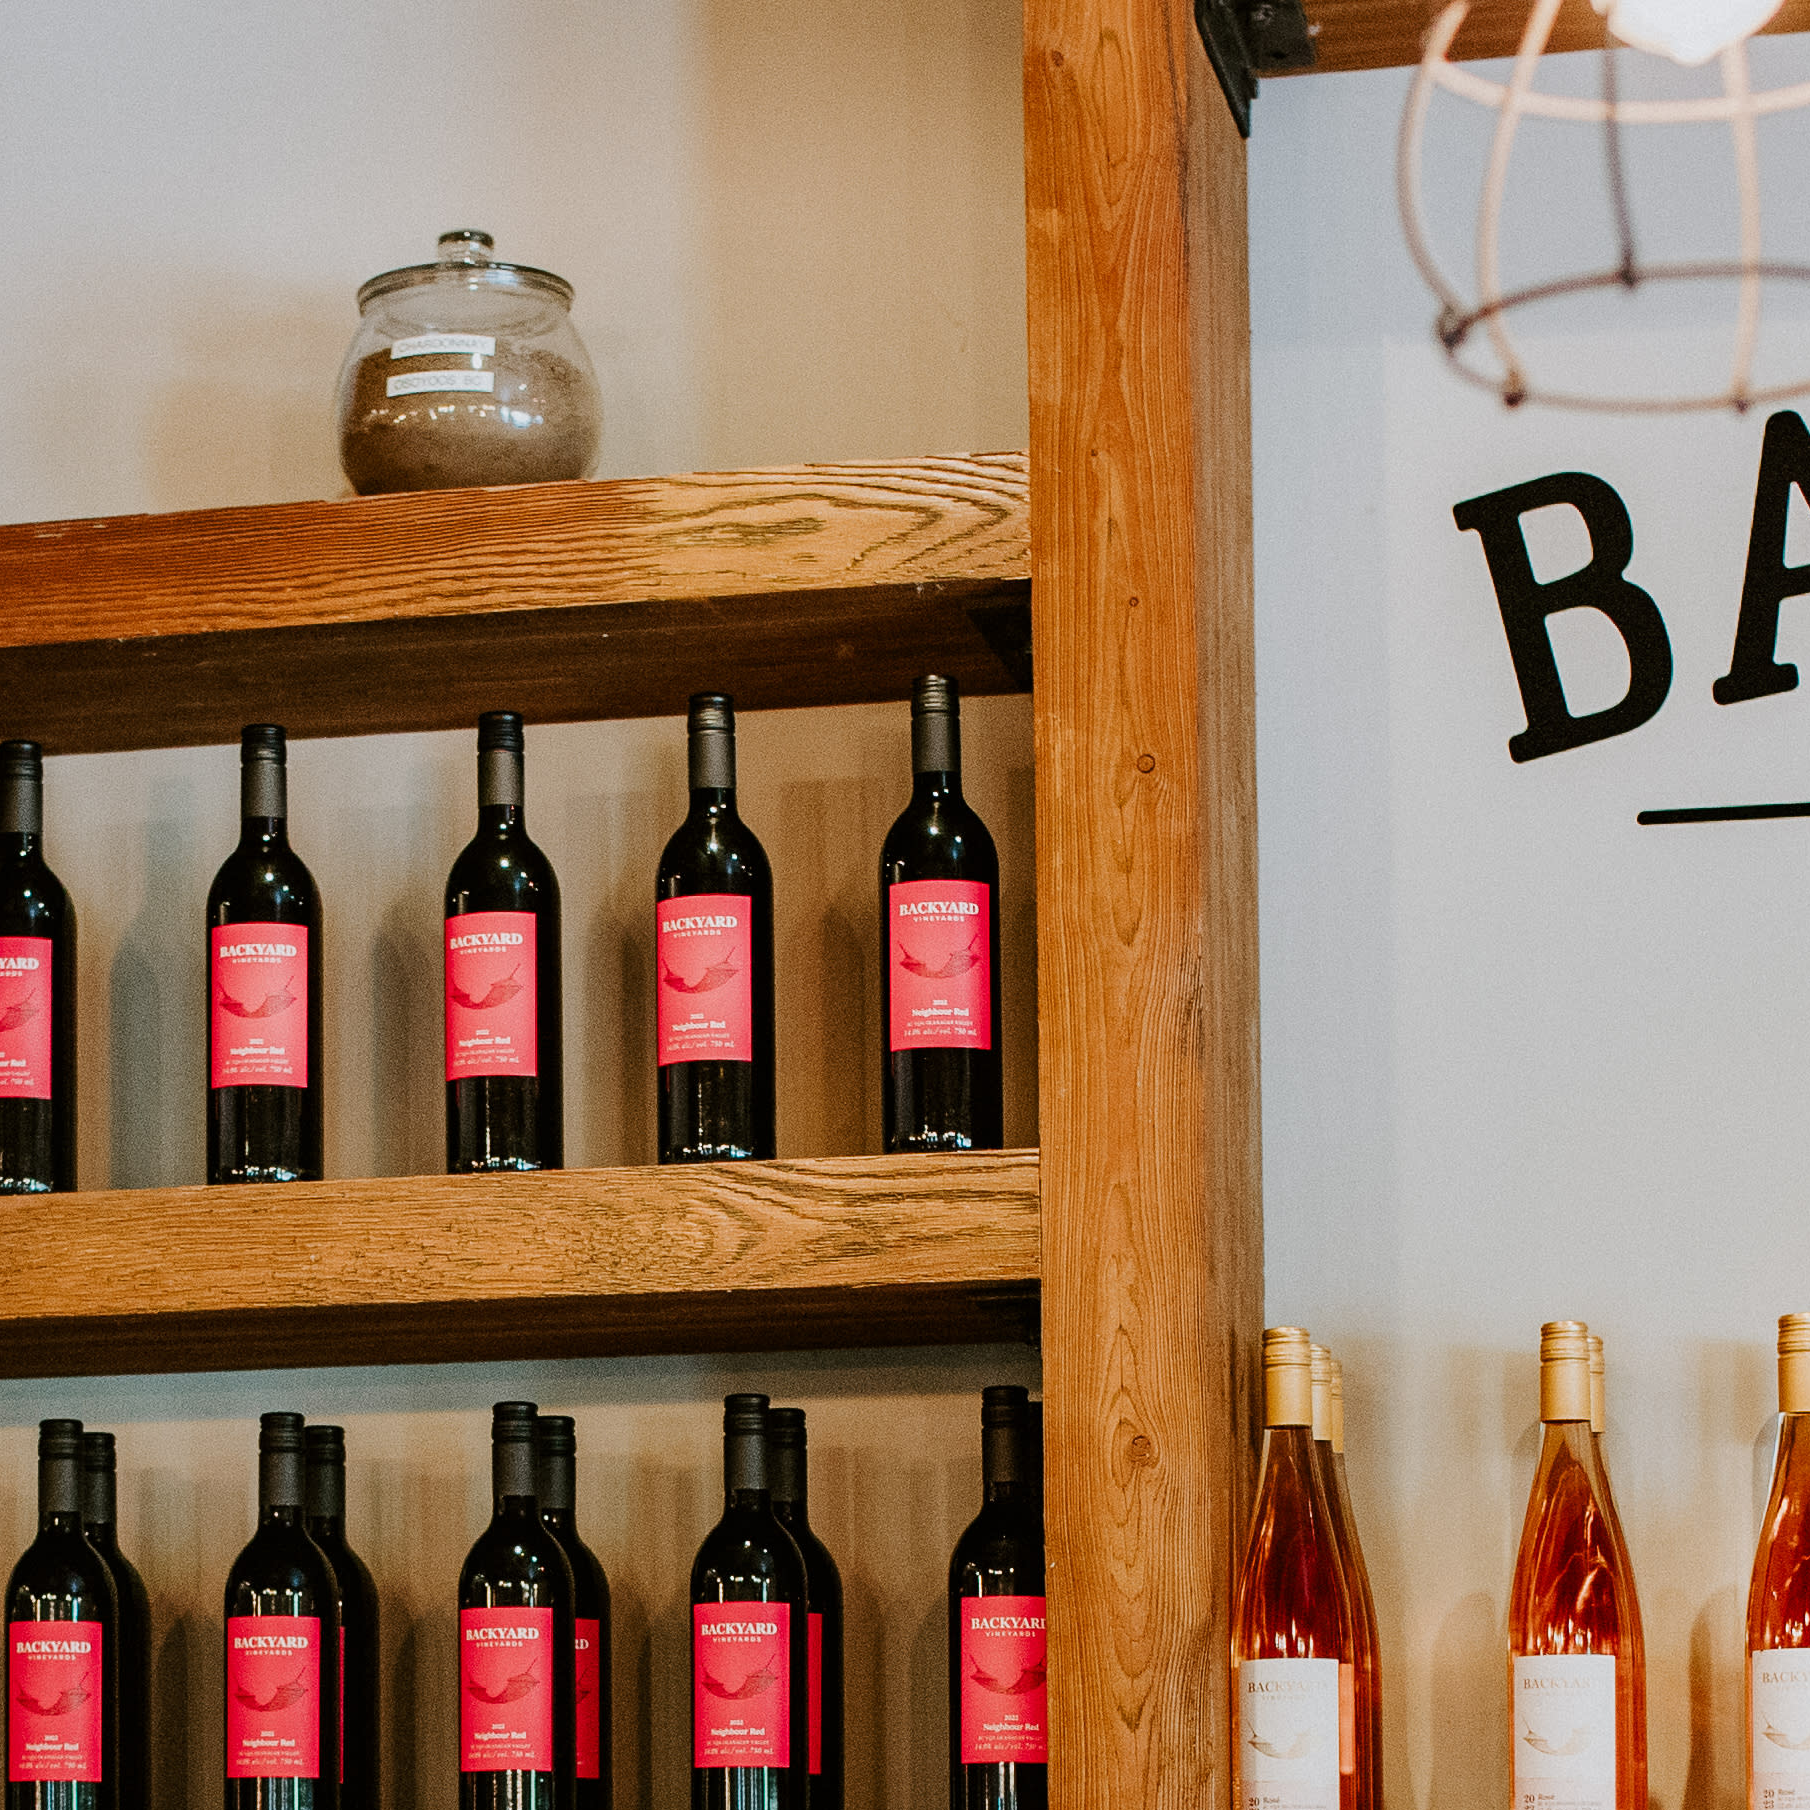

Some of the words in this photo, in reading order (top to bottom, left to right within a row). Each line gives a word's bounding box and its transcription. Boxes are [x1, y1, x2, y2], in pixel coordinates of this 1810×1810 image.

[899, 901, 980, 917] BACKYARD
[662, 915, 737, 933] BACKYARD
[450, 932, 523, 950] BACKYARD
[219, 943, 297, 958] BACKYARD
[953, 1007, 969, 1016] Red
[466, 1627, 540, 1642] BACKYARD
[701, 1622, 778, 1637] BACKYARD
[16, 1641, 92, 1655] BACKYARD
[233, 1636, 309, 1650] BACKYARD
[749, 1727, 765, 1736] Red
[983, 1723, 1023, 1733] Neighbour
[1024, 1722, 1039, 1731] Red
